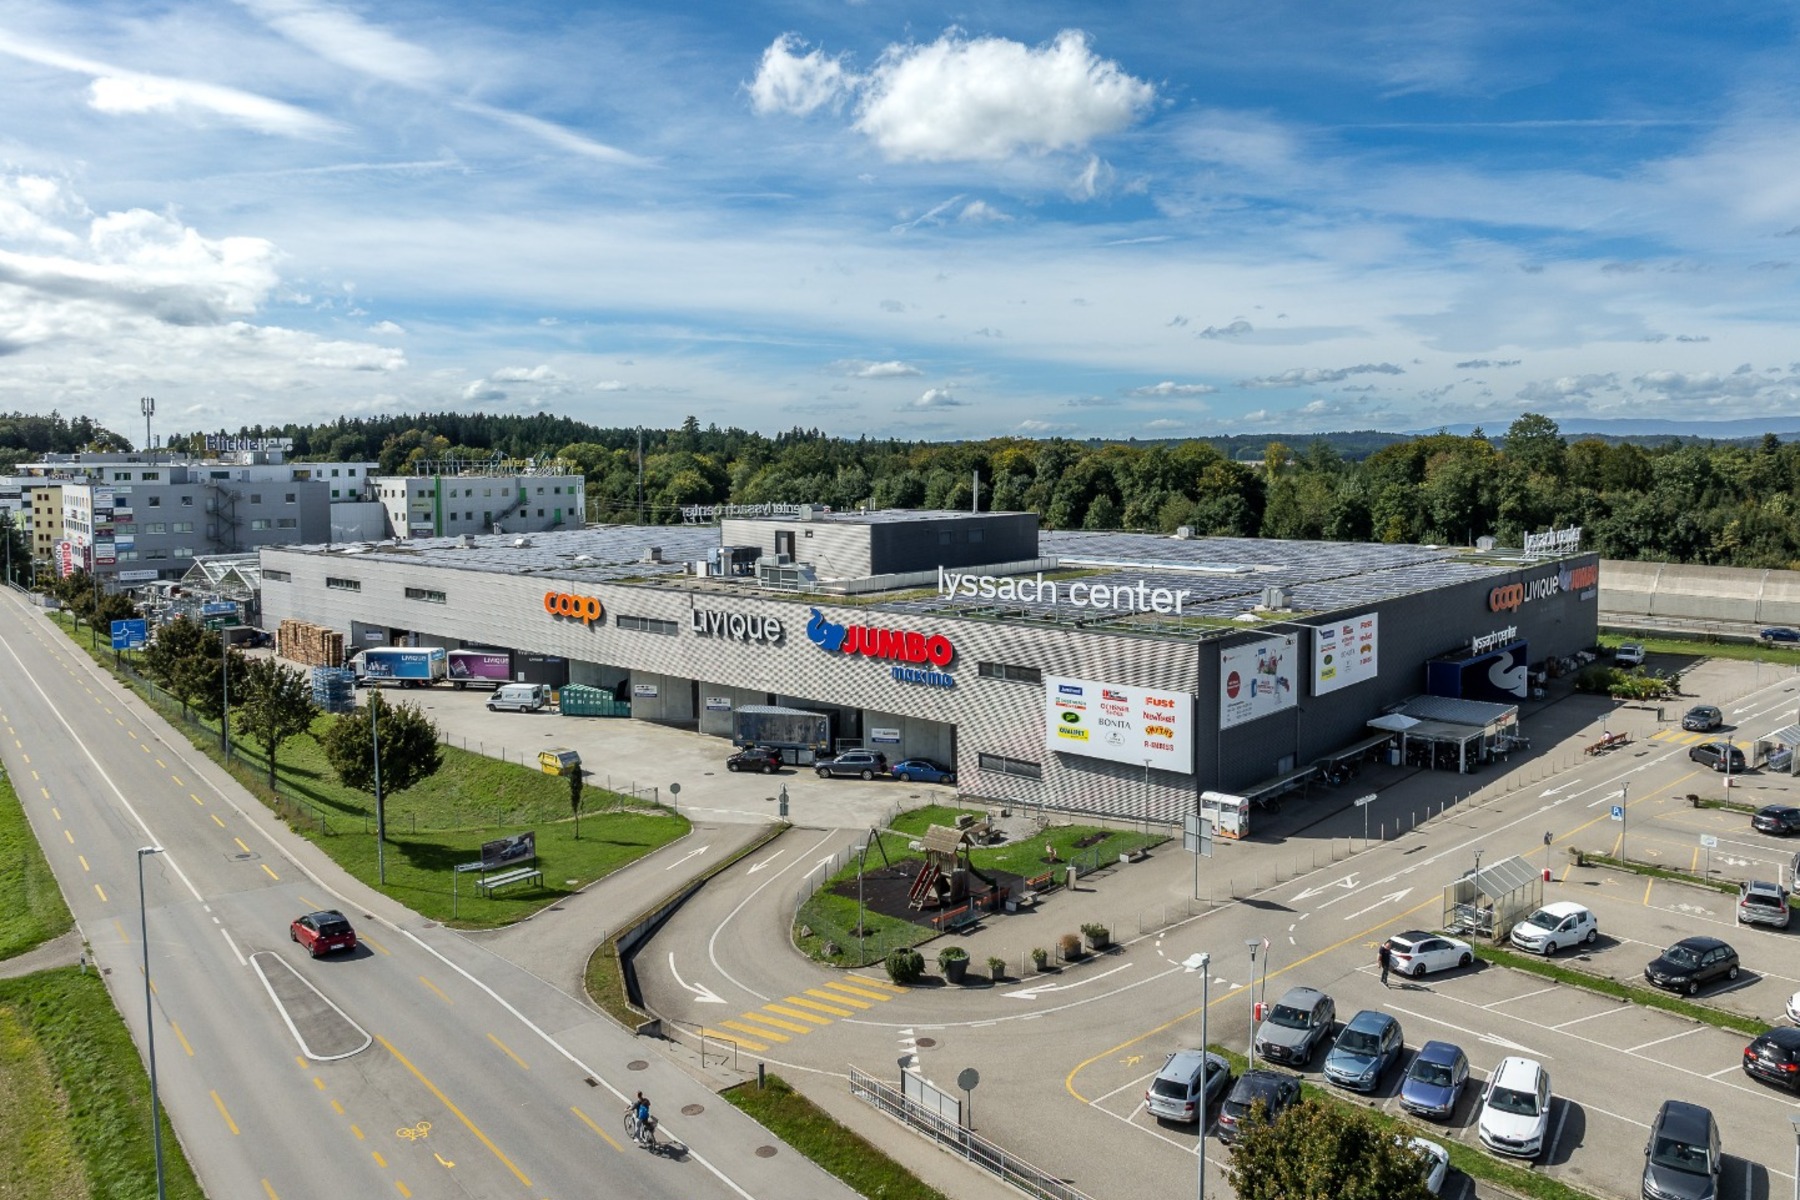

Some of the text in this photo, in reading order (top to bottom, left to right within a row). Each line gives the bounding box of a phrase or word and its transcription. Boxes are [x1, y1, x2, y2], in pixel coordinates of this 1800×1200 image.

[938, 565, 1191, 614] lyssach center
[1490, 583, 1523, 613] coop
[544, 591, 602, 625] coop
[842, 625, 953, 666] JUMBO
[1098, 717, 1131, 730] BONITA
